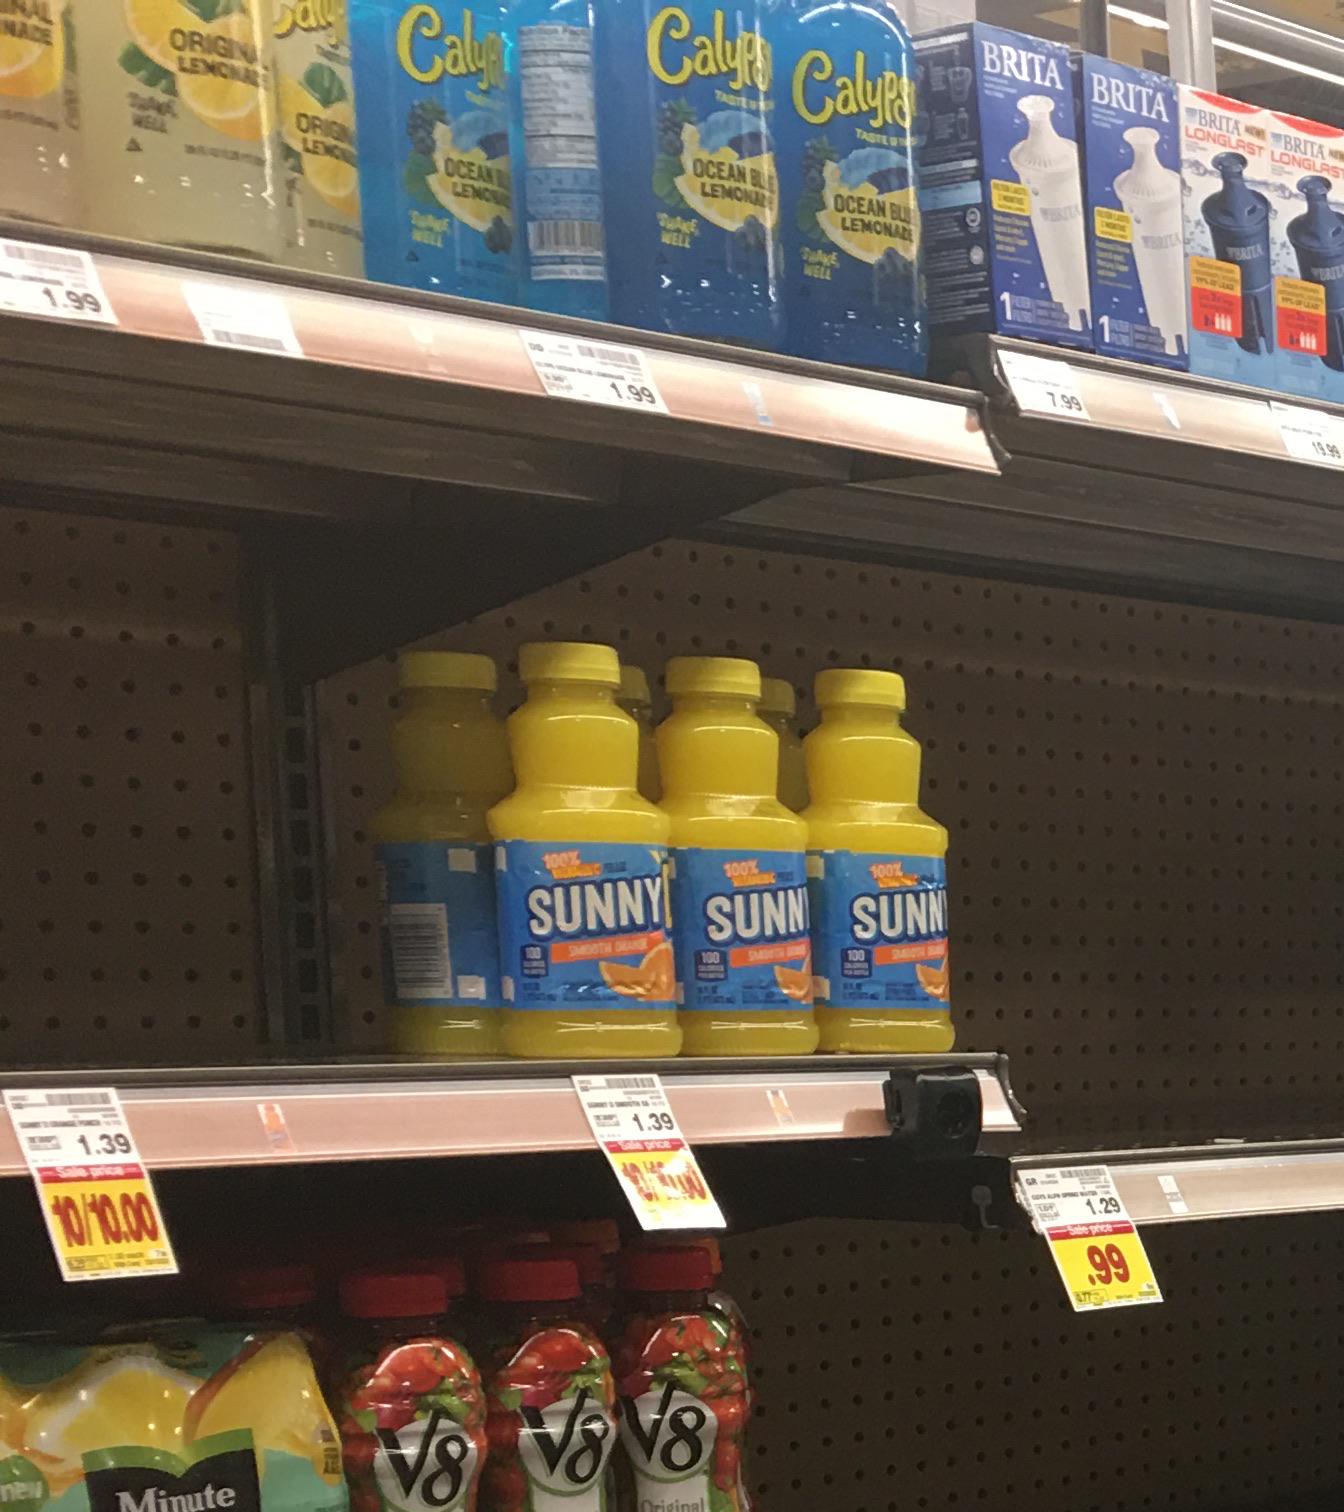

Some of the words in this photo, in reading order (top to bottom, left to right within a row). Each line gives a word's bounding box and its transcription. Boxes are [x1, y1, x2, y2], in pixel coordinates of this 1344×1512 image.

[170, 28, 260, 63] ORIGINA
[982, 41, 1063, 91] BRITA
[1091, 73, 1170, 122] BRITA
[1199, 108, 1241, 136] BRITA
[1185, 126, 1264, 157] LONGLAST
[1283, 133, 1325, 160] BRITA
[693, 159, 747, 181] OCEAN
[834, 194, 886, 216] OCEAN
[42, 287, 102, 313] 1.99
[610, 381, 656, 405] 1.99
[1045, 391, 1084, 412] 7.99
[1312, 439, 1343, 460] 19.99
[528, 875, 662, 937] SUNNY
[705, 887, 809, 943] SUNN
[632, 1112, 674, 1132] 1.39
[76, 1132, 132, 1157] 1.39
[56, 1165, 89, 1179] Sale
[90, 1164, 125, 1181] price
[1025, 1178, 1038, 1187] GR
[51, 1190, 161, 1249] 10/10.00
[1085, 1196, 1121, 1216] 1.29
[1087, 1243, 1131, 1287] .99
[520, 1386, 610, 1485] V8
[619, 1381, 707, 1473] V8
[376, 1409, 469, 1508] V8
